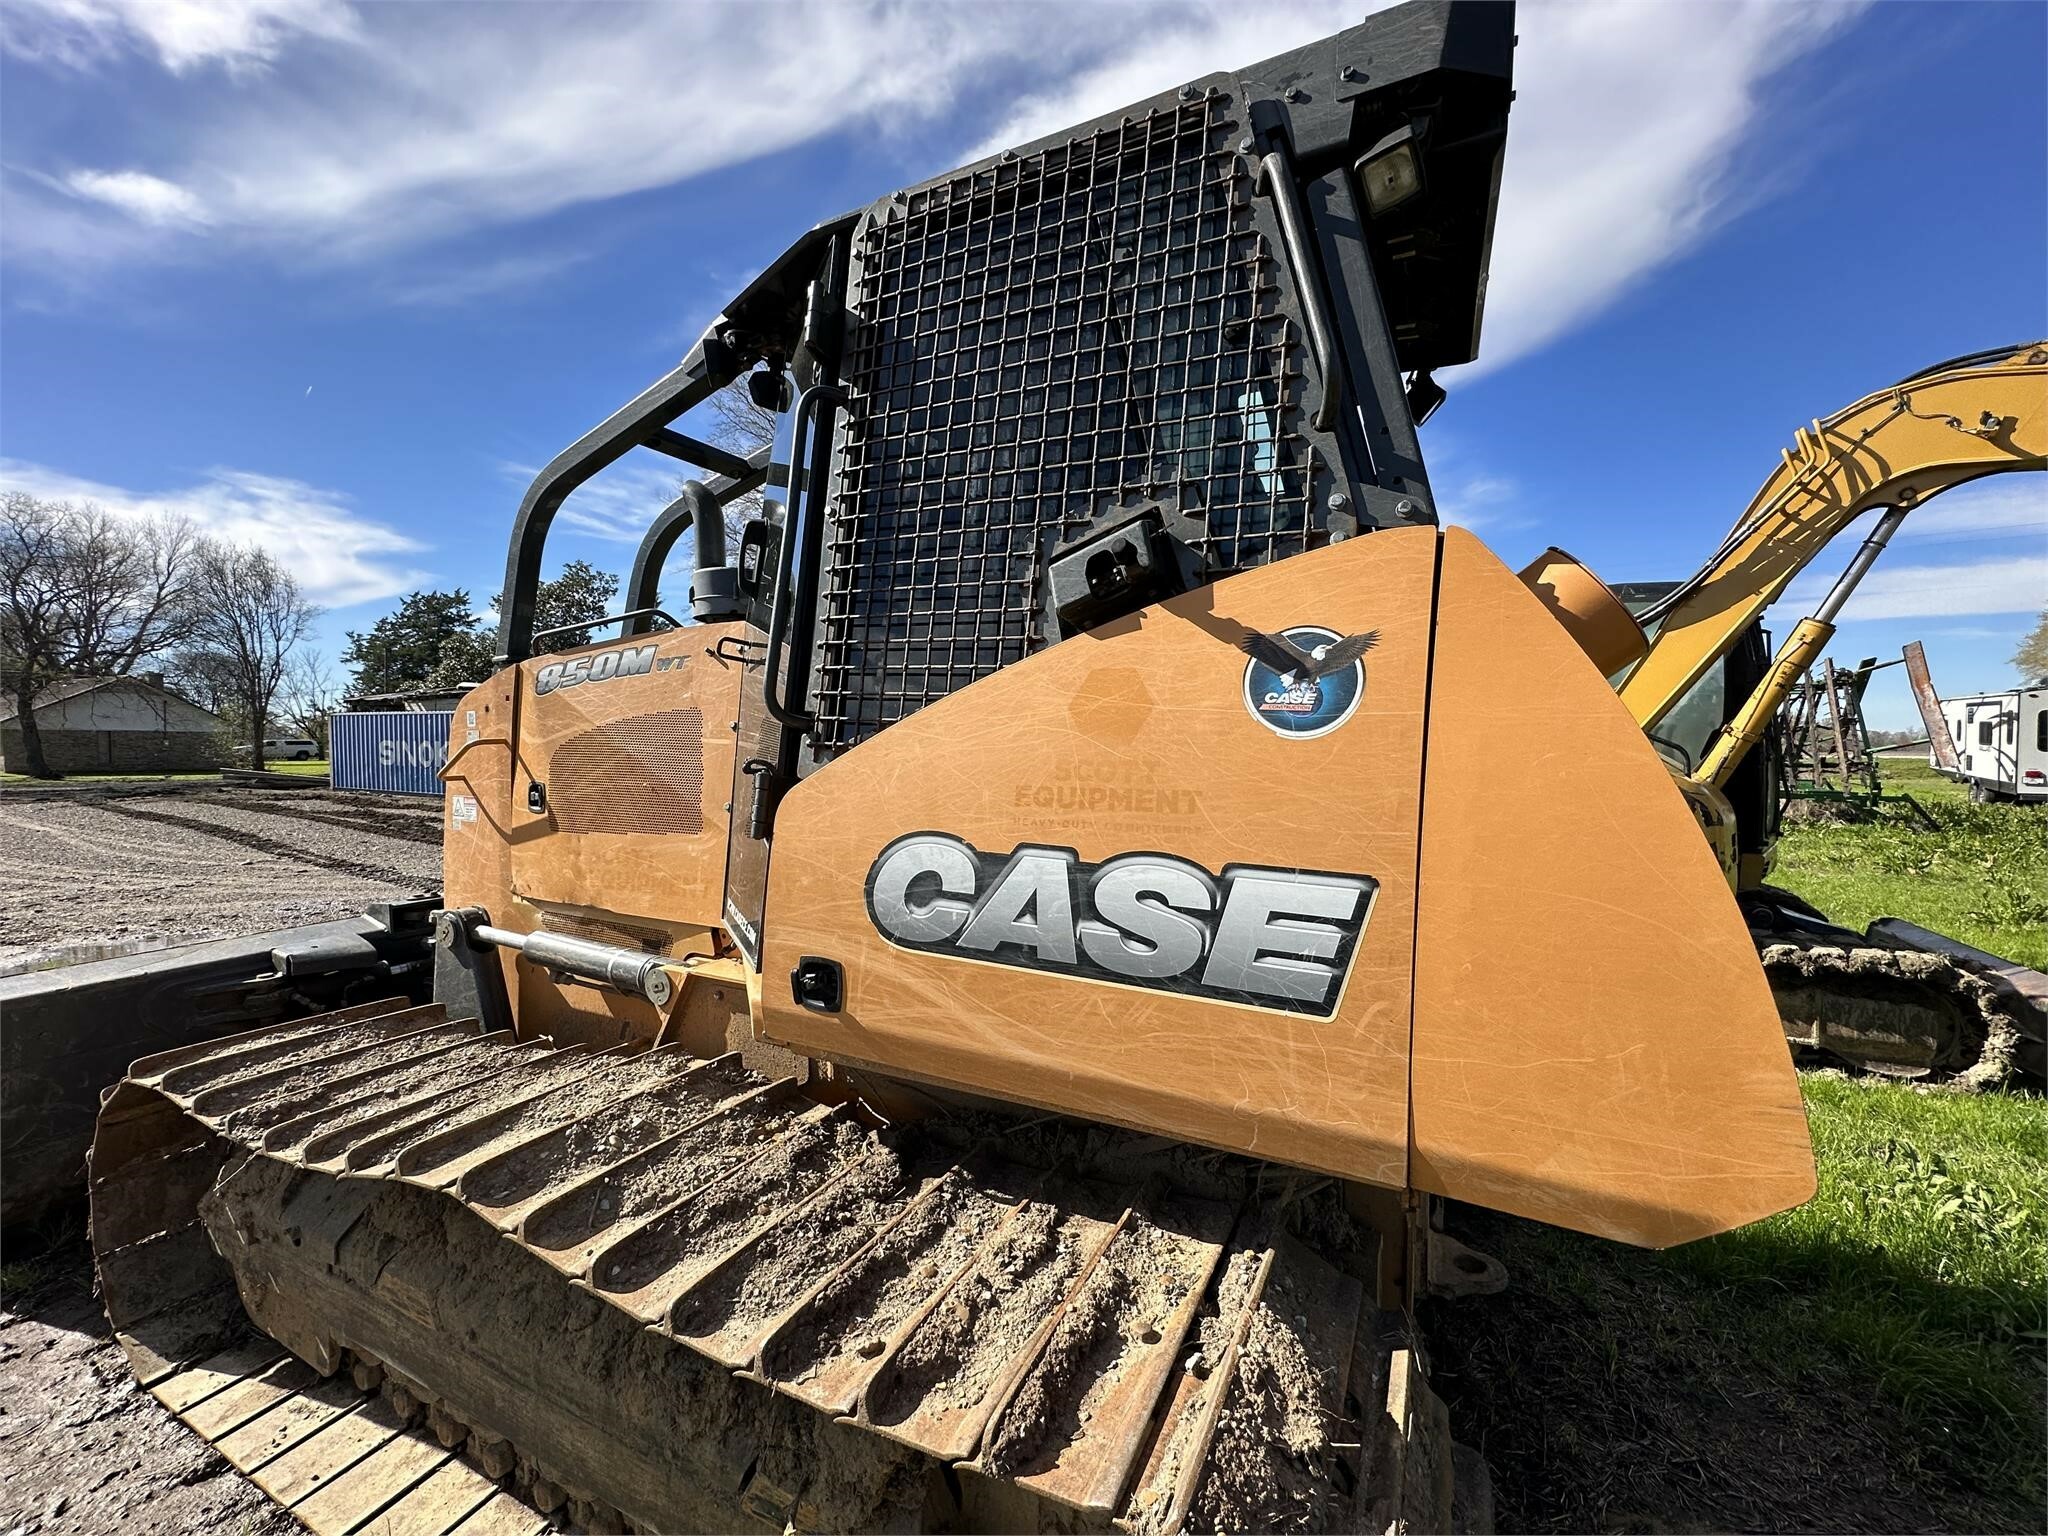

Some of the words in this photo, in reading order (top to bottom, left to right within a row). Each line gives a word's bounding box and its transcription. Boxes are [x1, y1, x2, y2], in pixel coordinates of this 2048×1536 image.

[535, 644, 659, 696] 850M
[656, 655, 691, 673] WT
[1264, 690, 1318, 704] CASE
[1014, 785, 1204, 814] EQUIPMENT
[873, 843, 1361, 1003] CASE
